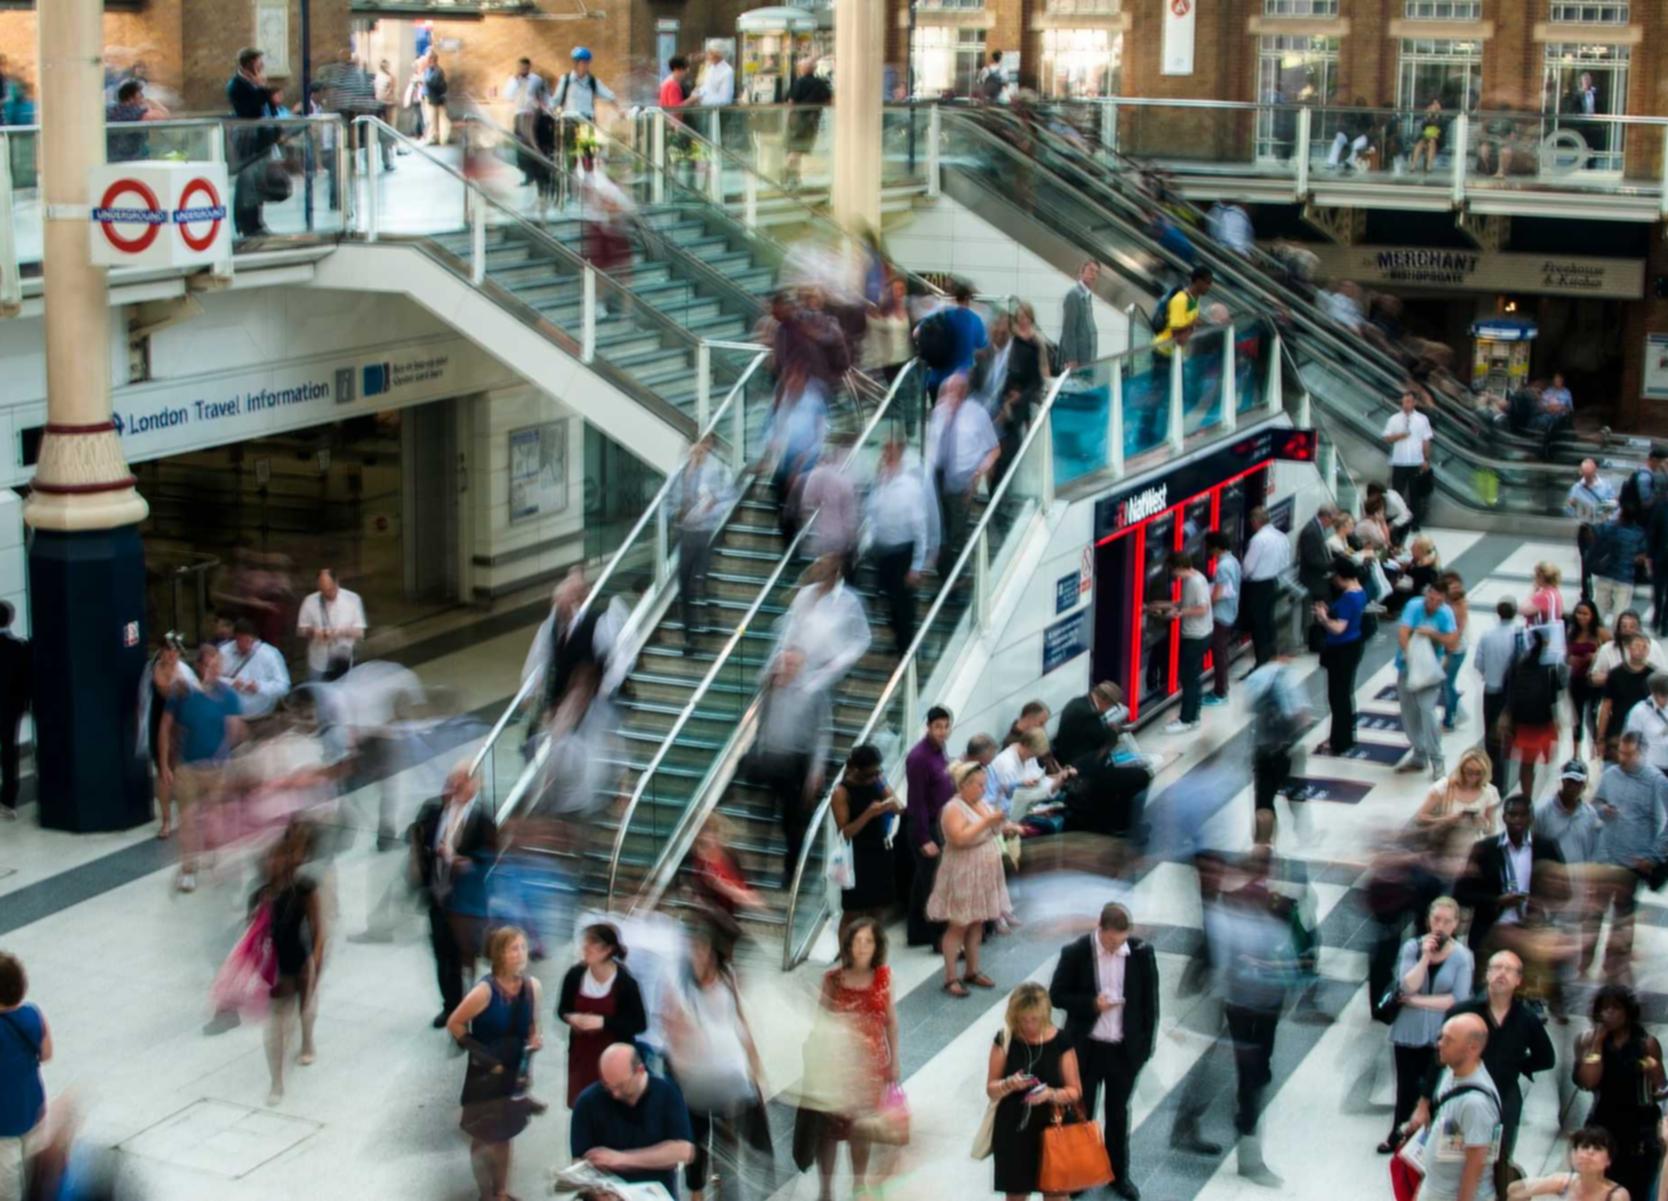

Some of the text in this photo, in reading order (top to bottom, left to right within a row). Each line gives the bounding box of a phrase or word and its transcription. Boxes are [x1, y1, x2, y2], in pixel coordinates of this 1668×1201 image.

[96, 209, 165, 221] UNDERGROUND
[176, 206, 225, 221] UNDERGROUND
[1377, 250, 1478, 273] MERCHANT
[129, 381, 329, 435] London Travel Information
[1128, 482, 1168, 525] NatWest
